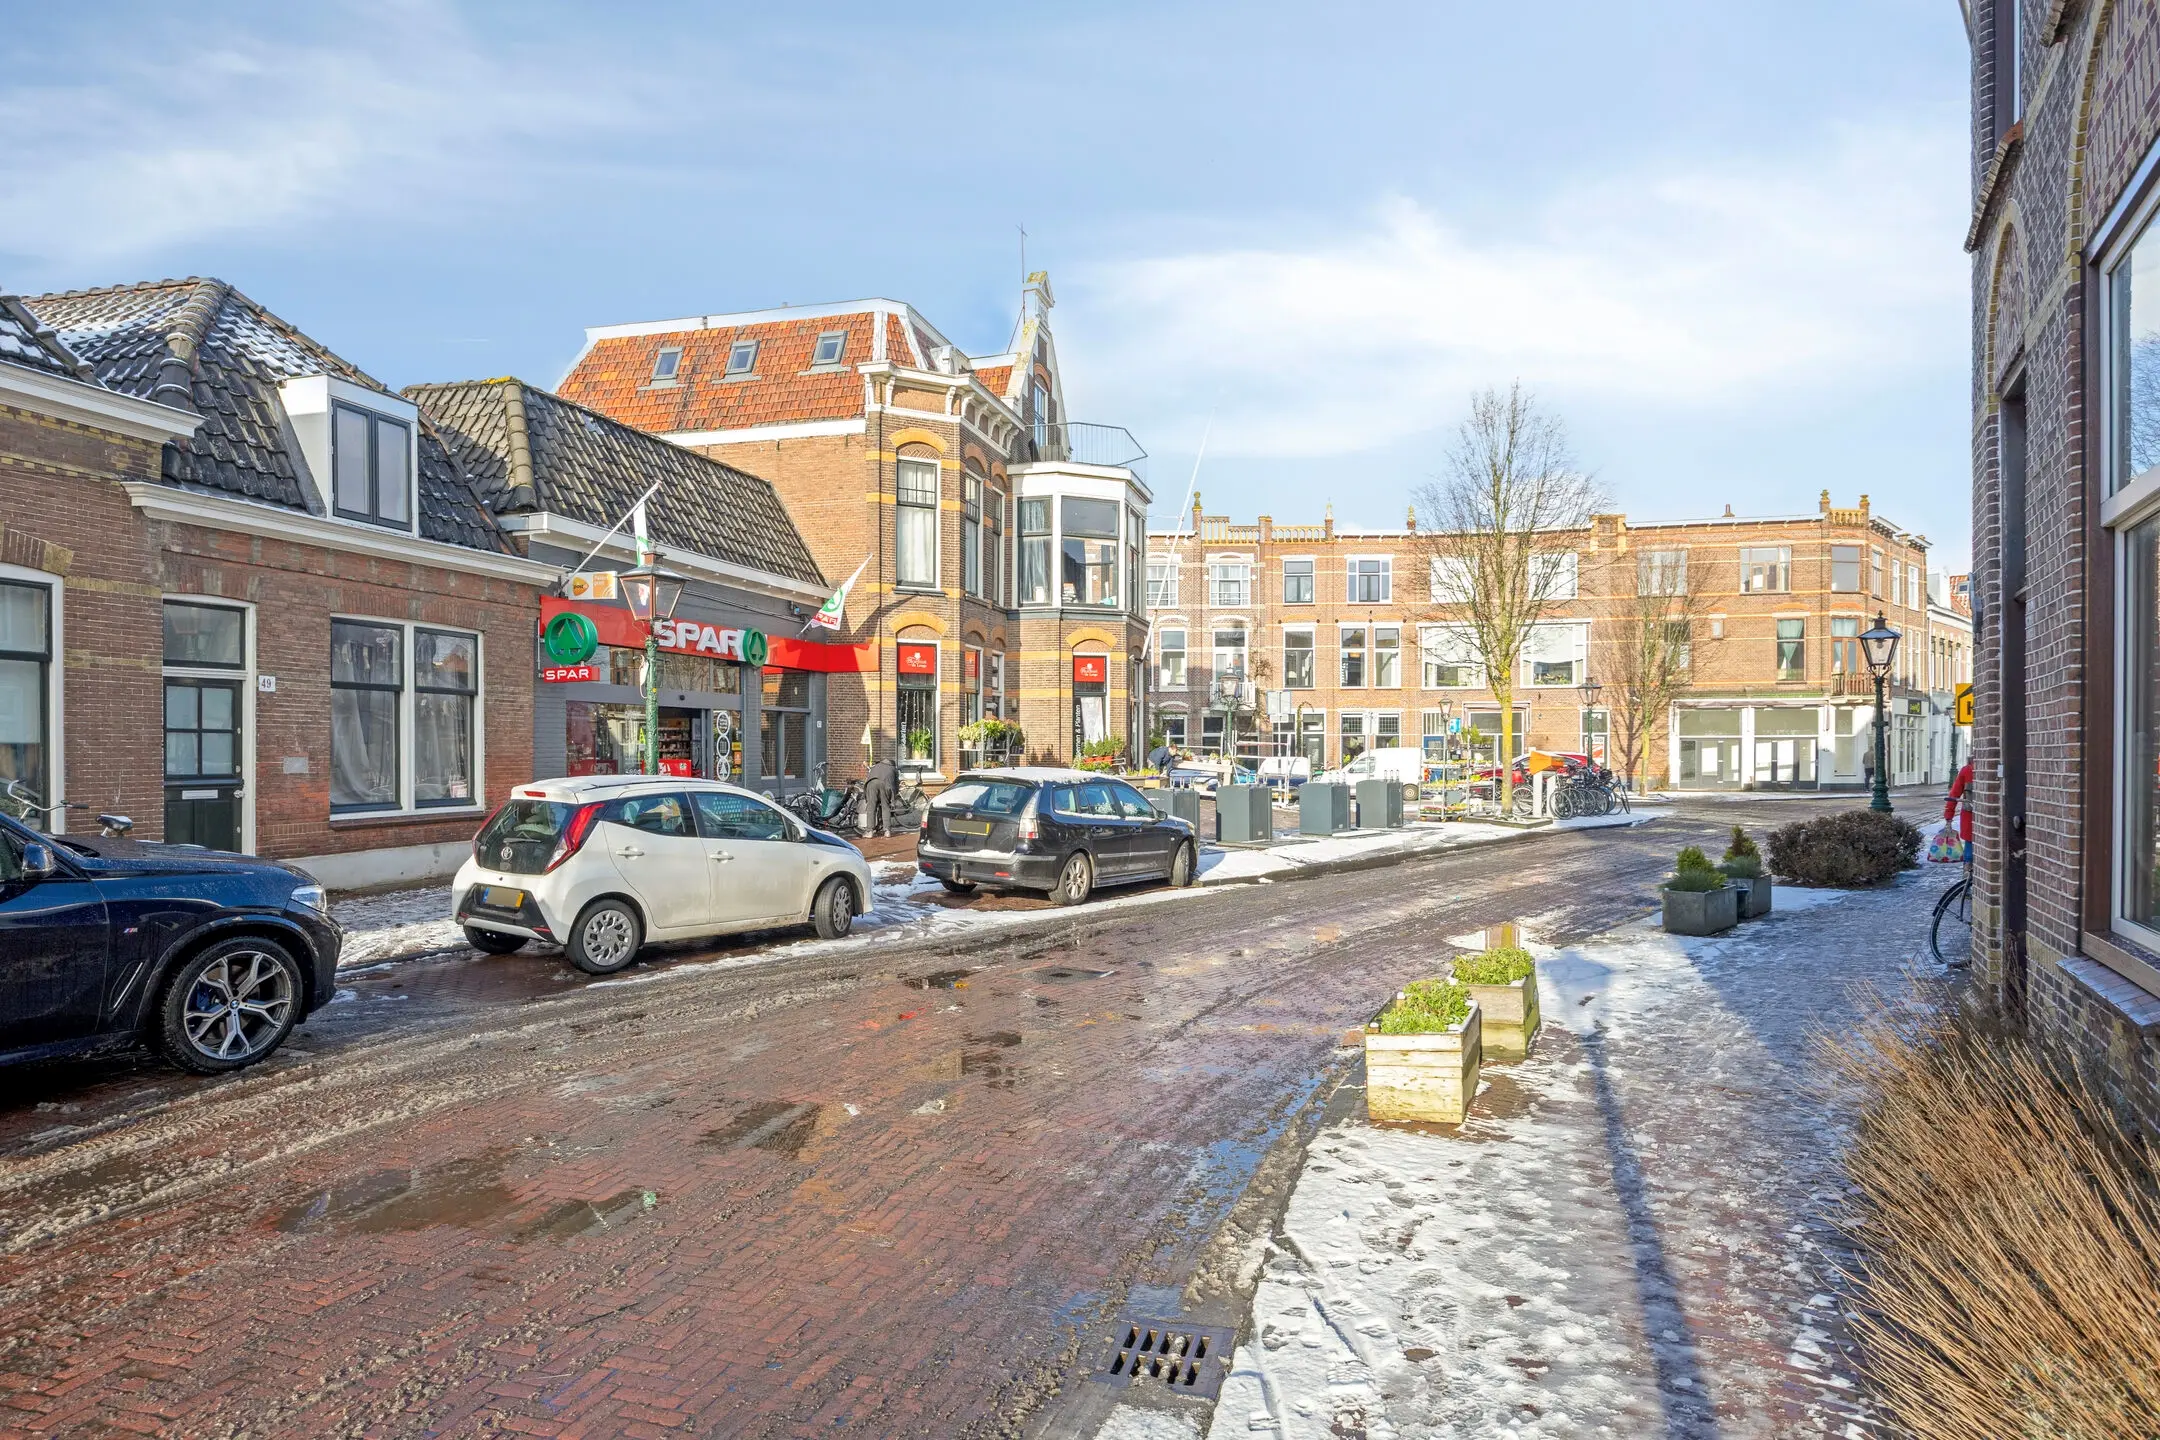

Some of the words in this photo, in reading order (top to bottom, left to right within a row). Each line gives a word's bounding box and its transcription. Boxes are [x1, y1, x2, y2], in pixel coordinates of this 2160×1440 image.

[654, 620, 740, 656] SPAR
[545, 668, 589, 680] SPAR
[261, 678, 271, 688] 49
